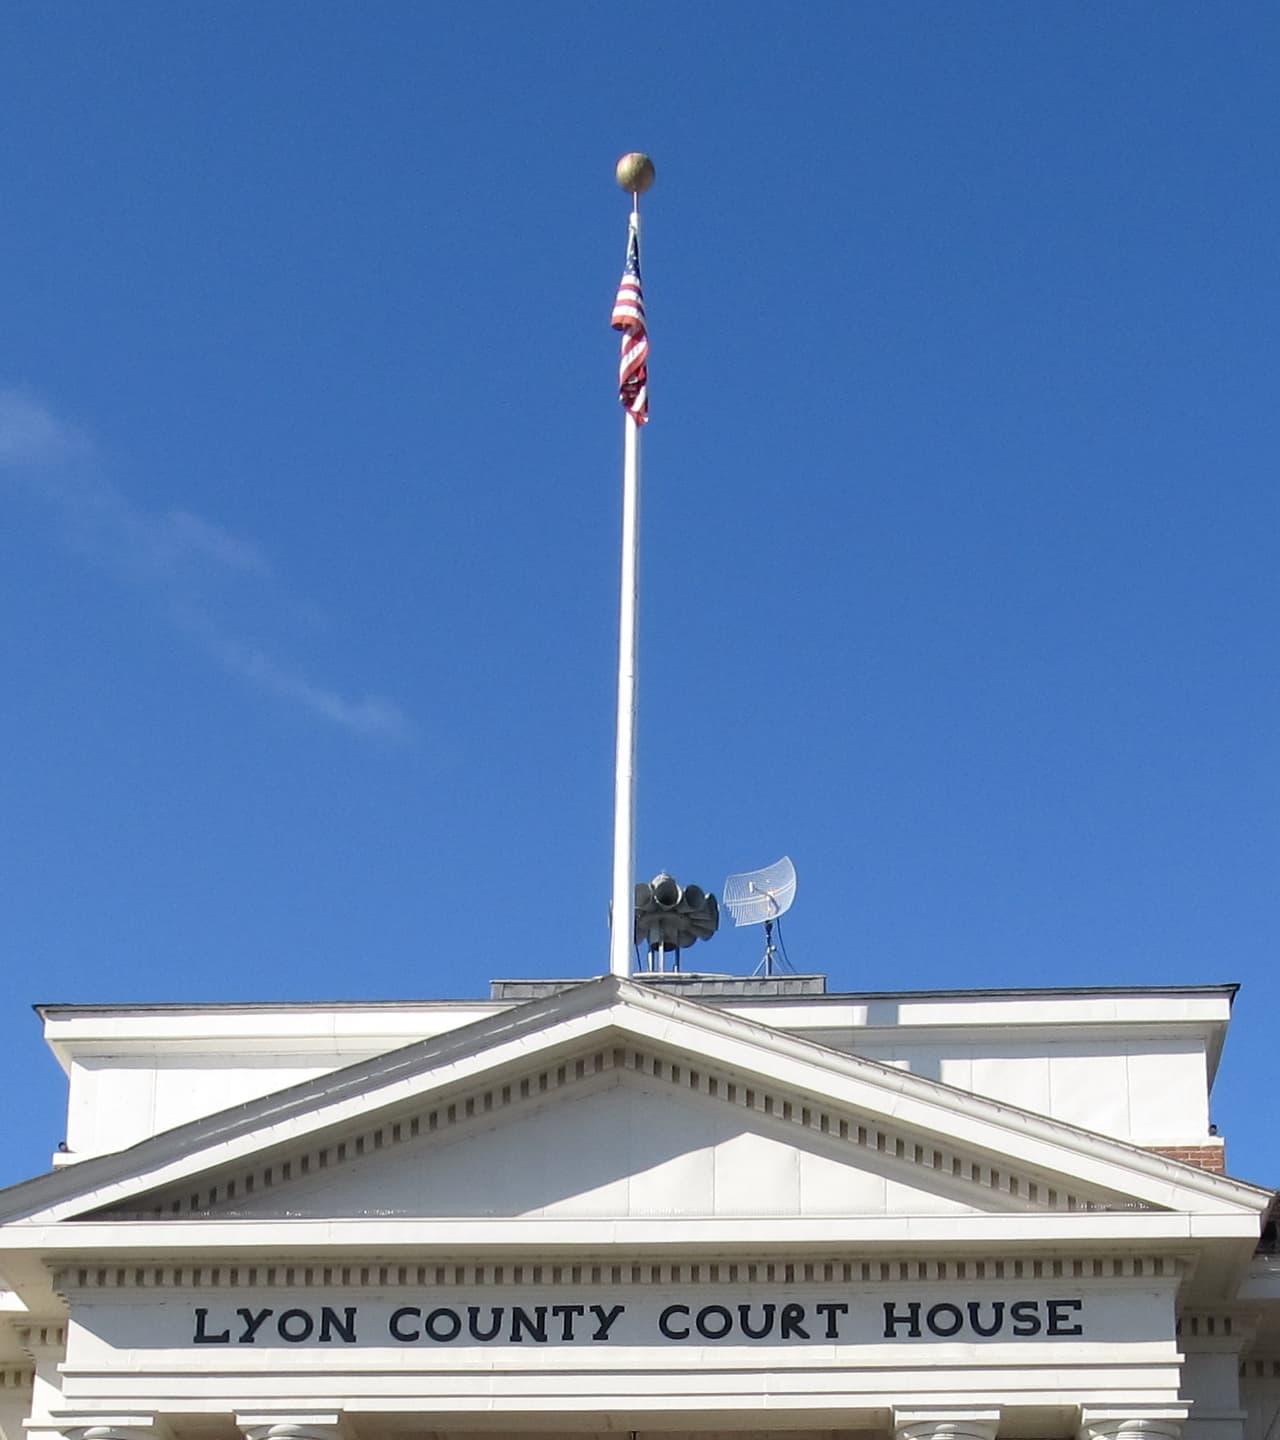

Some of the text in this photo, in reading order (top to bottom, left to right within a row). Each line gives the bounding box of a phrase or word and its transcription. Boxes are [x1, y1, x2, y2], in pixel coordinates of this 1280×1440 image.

[193, 1298, 1084, 1345] LYON COUNTY COURT HOUSE
